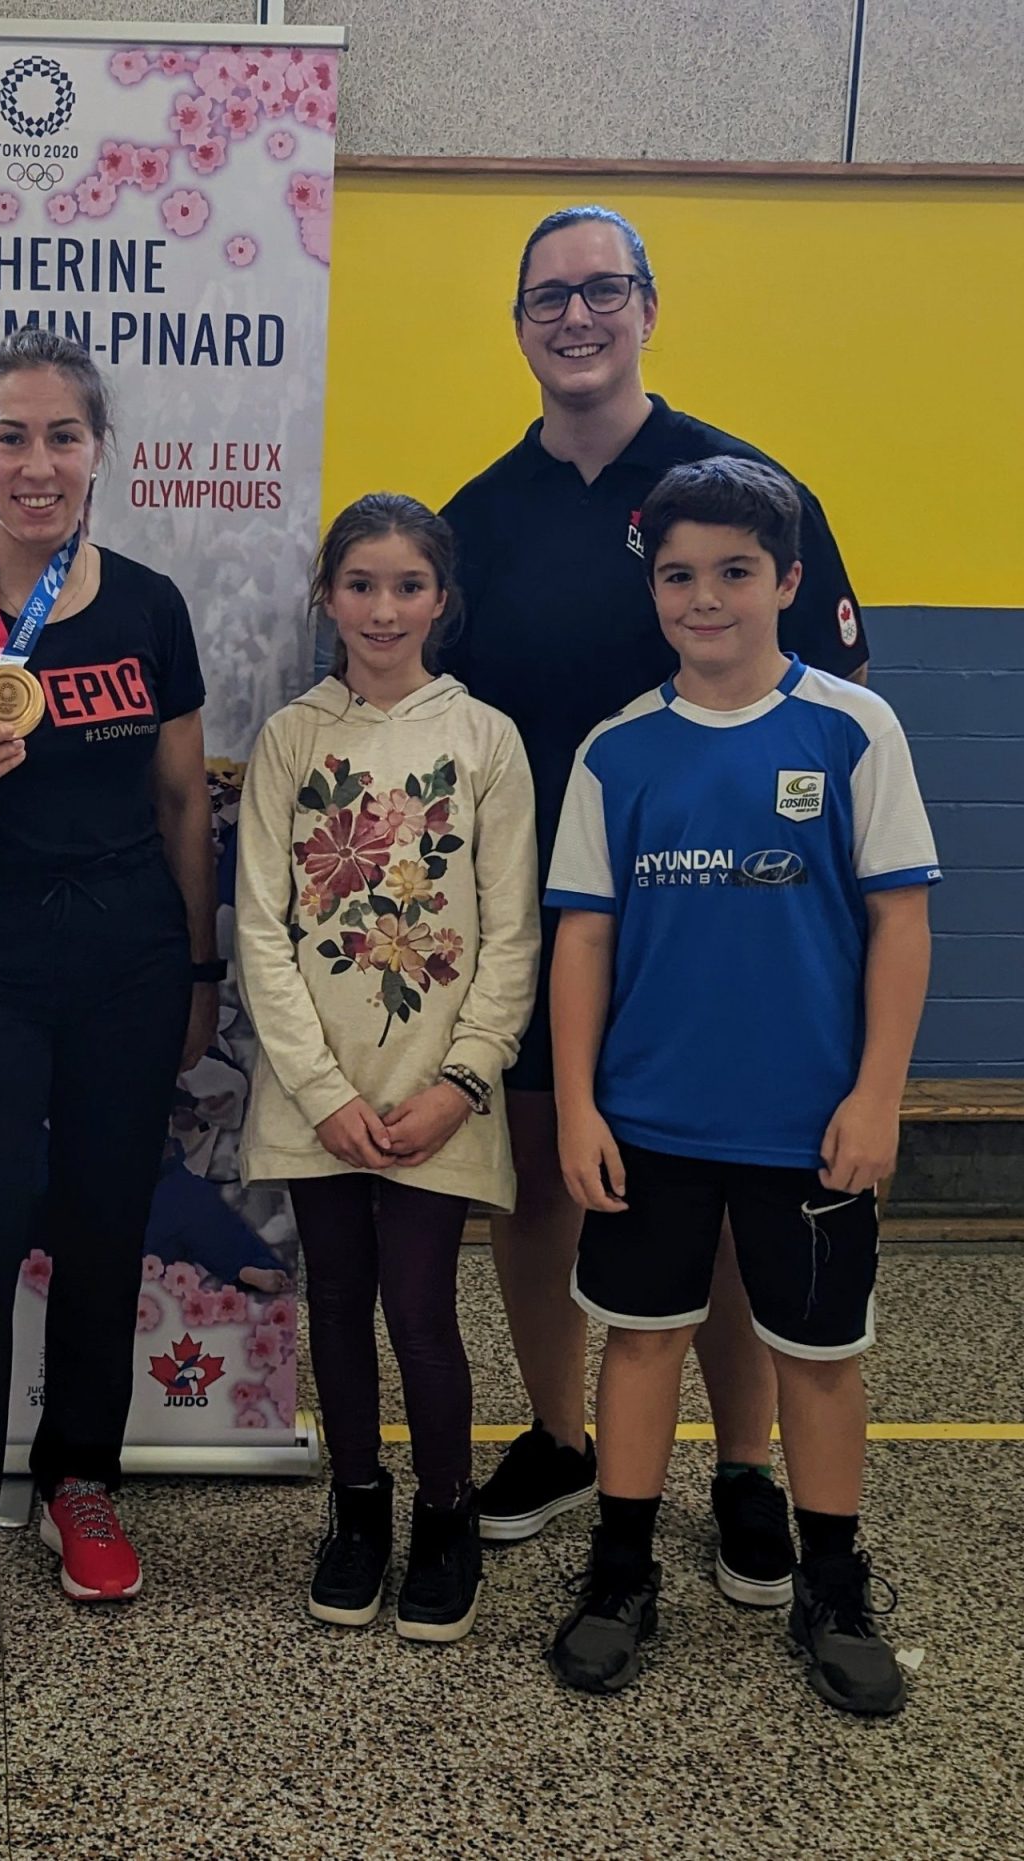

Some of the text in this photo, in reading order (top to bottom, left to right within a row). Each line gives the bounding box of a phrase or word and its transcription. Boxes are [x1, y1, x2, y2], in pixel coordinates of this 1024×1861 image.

[44, 145, 78, 158] 2020
[133, 442, 281, 471] AUX JEUX
[131, 480, 281, 512] OLYMPIQUES
[48, 664, 146, 719] EPIC
[635, 849, 733, 874] HYUNDAI
[638, 873, 728, 887] GRANBY
[164, 1396, 208, 1407] JUDO
